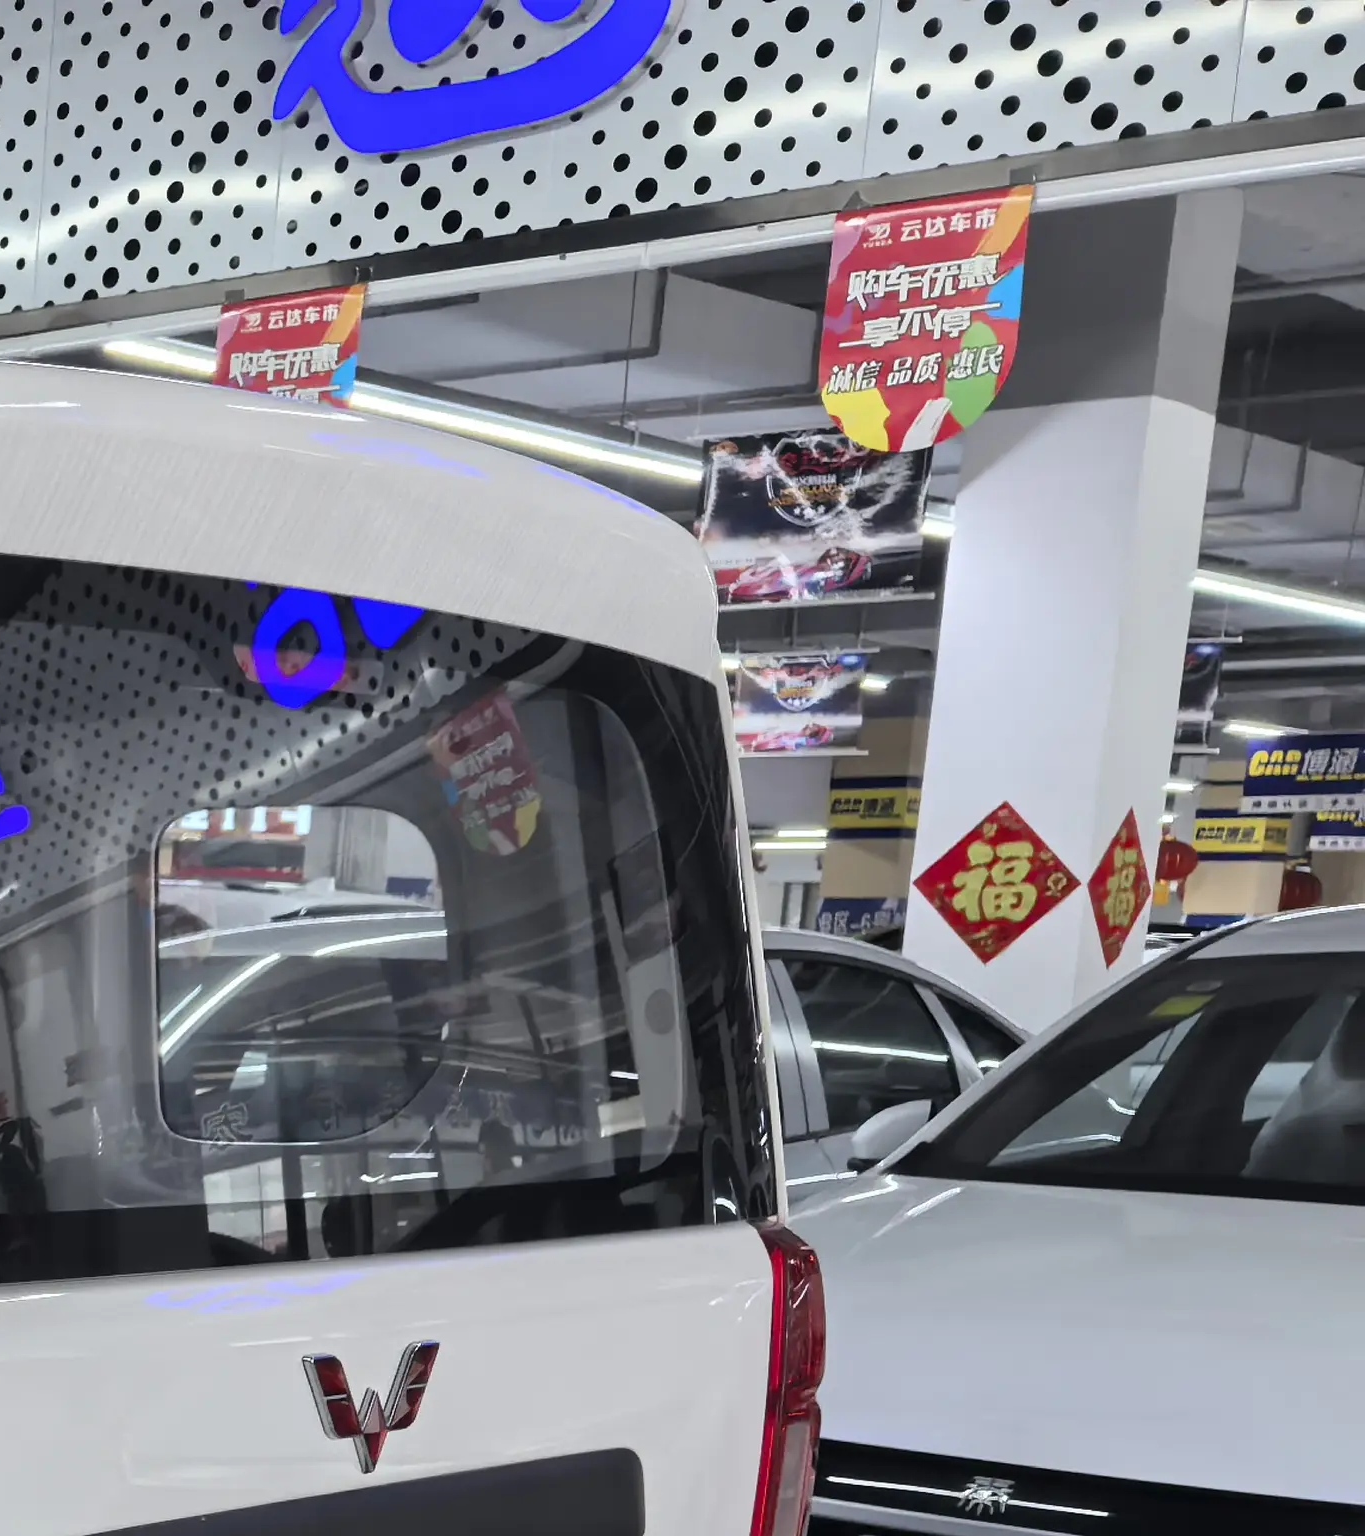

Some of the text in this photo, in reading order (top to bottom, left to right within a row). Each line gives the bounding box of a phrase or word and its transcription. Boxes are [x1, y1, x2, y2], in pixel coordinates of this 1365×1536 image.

[900, 208, 997, 242] 云达车市
[846, 253, 1007, 311] 购车优惠
[268, 303, 340, 330] 云达车市
[838, 303, 1002, 348] 享不停
[229, 343, 347, 387] 购车优惠
[826, 344, 1005, 394] 诚信 品质 惠民
[952, 840, 1038, 923] 福
[1103, 846, 1139, 928] 福
